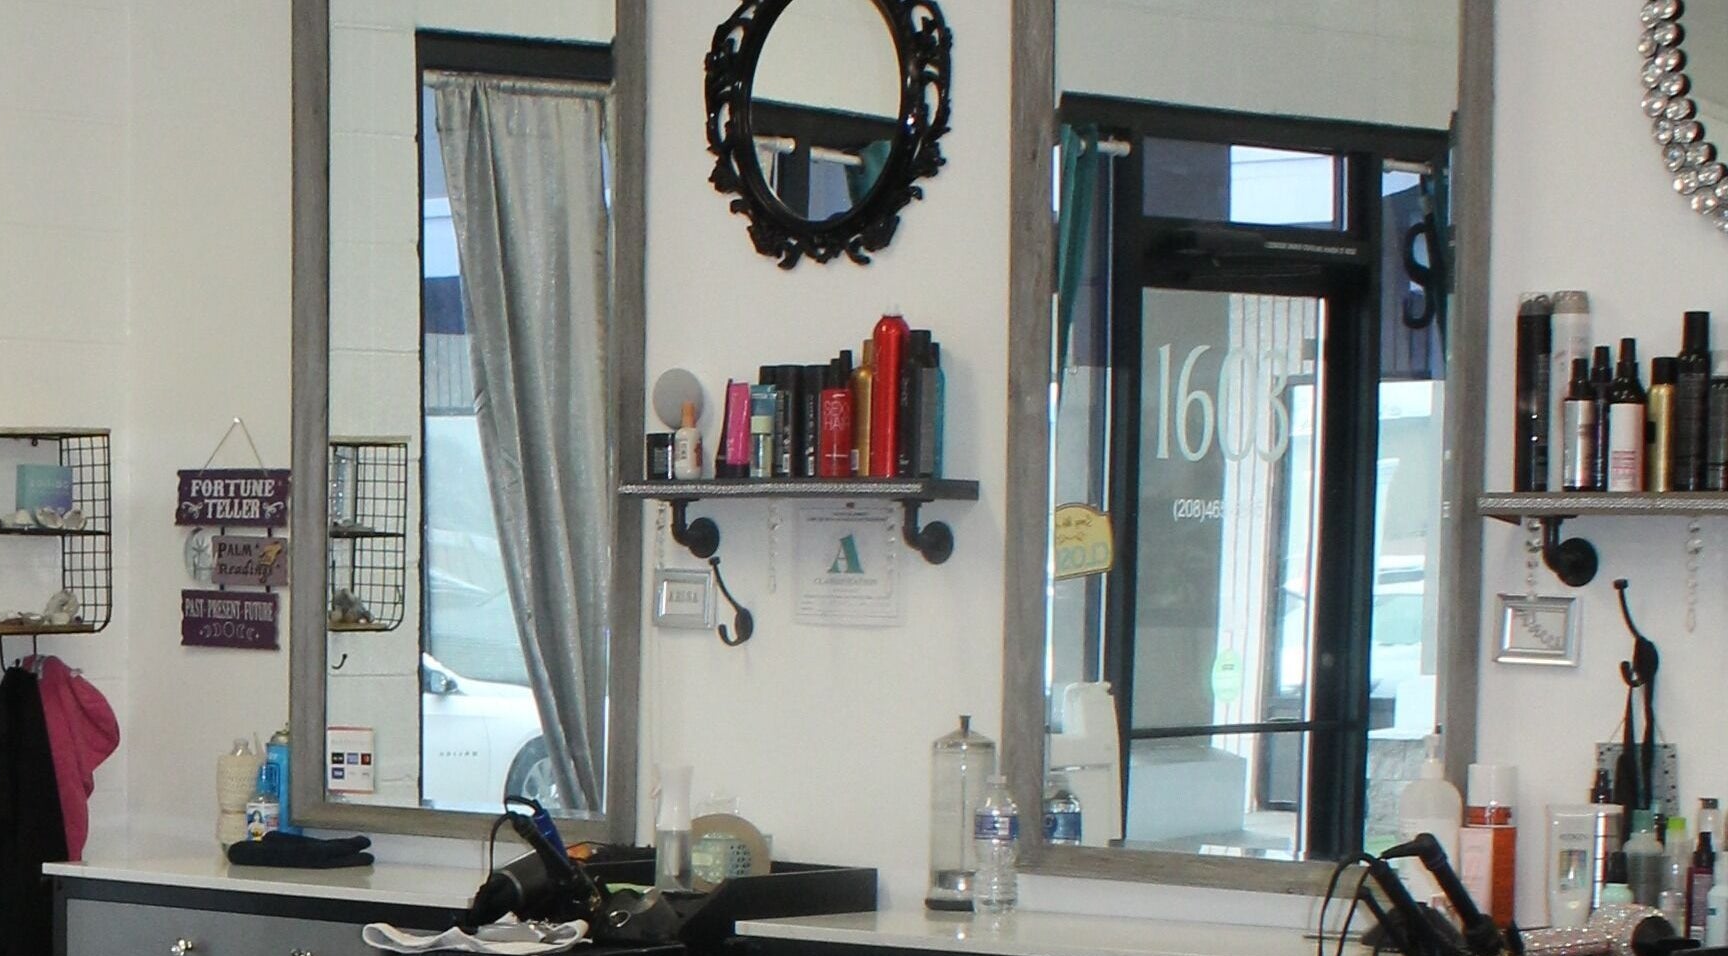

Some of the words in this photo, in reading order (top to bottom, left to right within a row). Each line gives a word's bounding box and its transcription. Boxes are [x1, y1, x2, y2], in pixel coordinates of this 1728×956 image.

[1156, 343, 1290, 463] 1603
[190, 479, 276, 497] FORTUNE
[204, 498, 261, 519] TELLER
[218, 542, 252, 560] PALM
[185, 598, 204, 618] PAST
[207, 599, 241, 620] PRESENT
[244, 601, 273, 622] FUTURE
